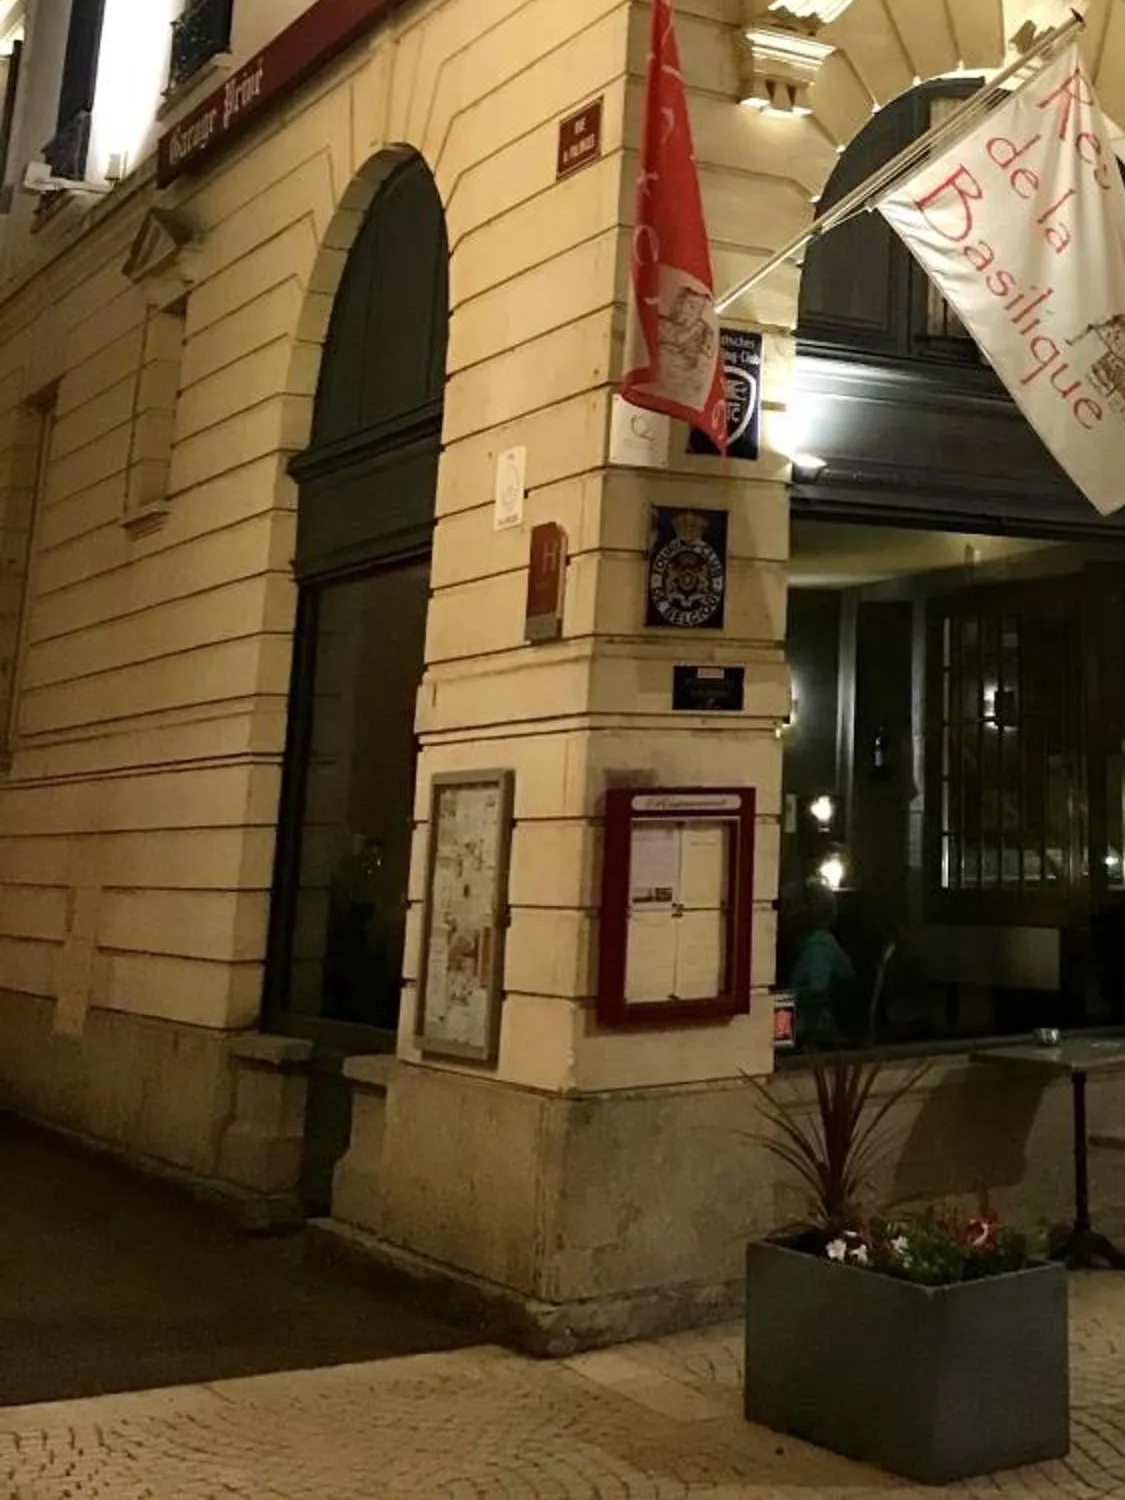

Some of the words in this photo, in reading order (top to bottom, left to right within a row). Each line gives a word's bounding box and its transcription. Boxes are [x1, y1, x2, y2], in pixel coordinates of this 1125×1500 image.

[985, 132, 1042, 200] de
[1036, 187, 1077, 255] la
[914, 163, 1104, 431] Basilique
